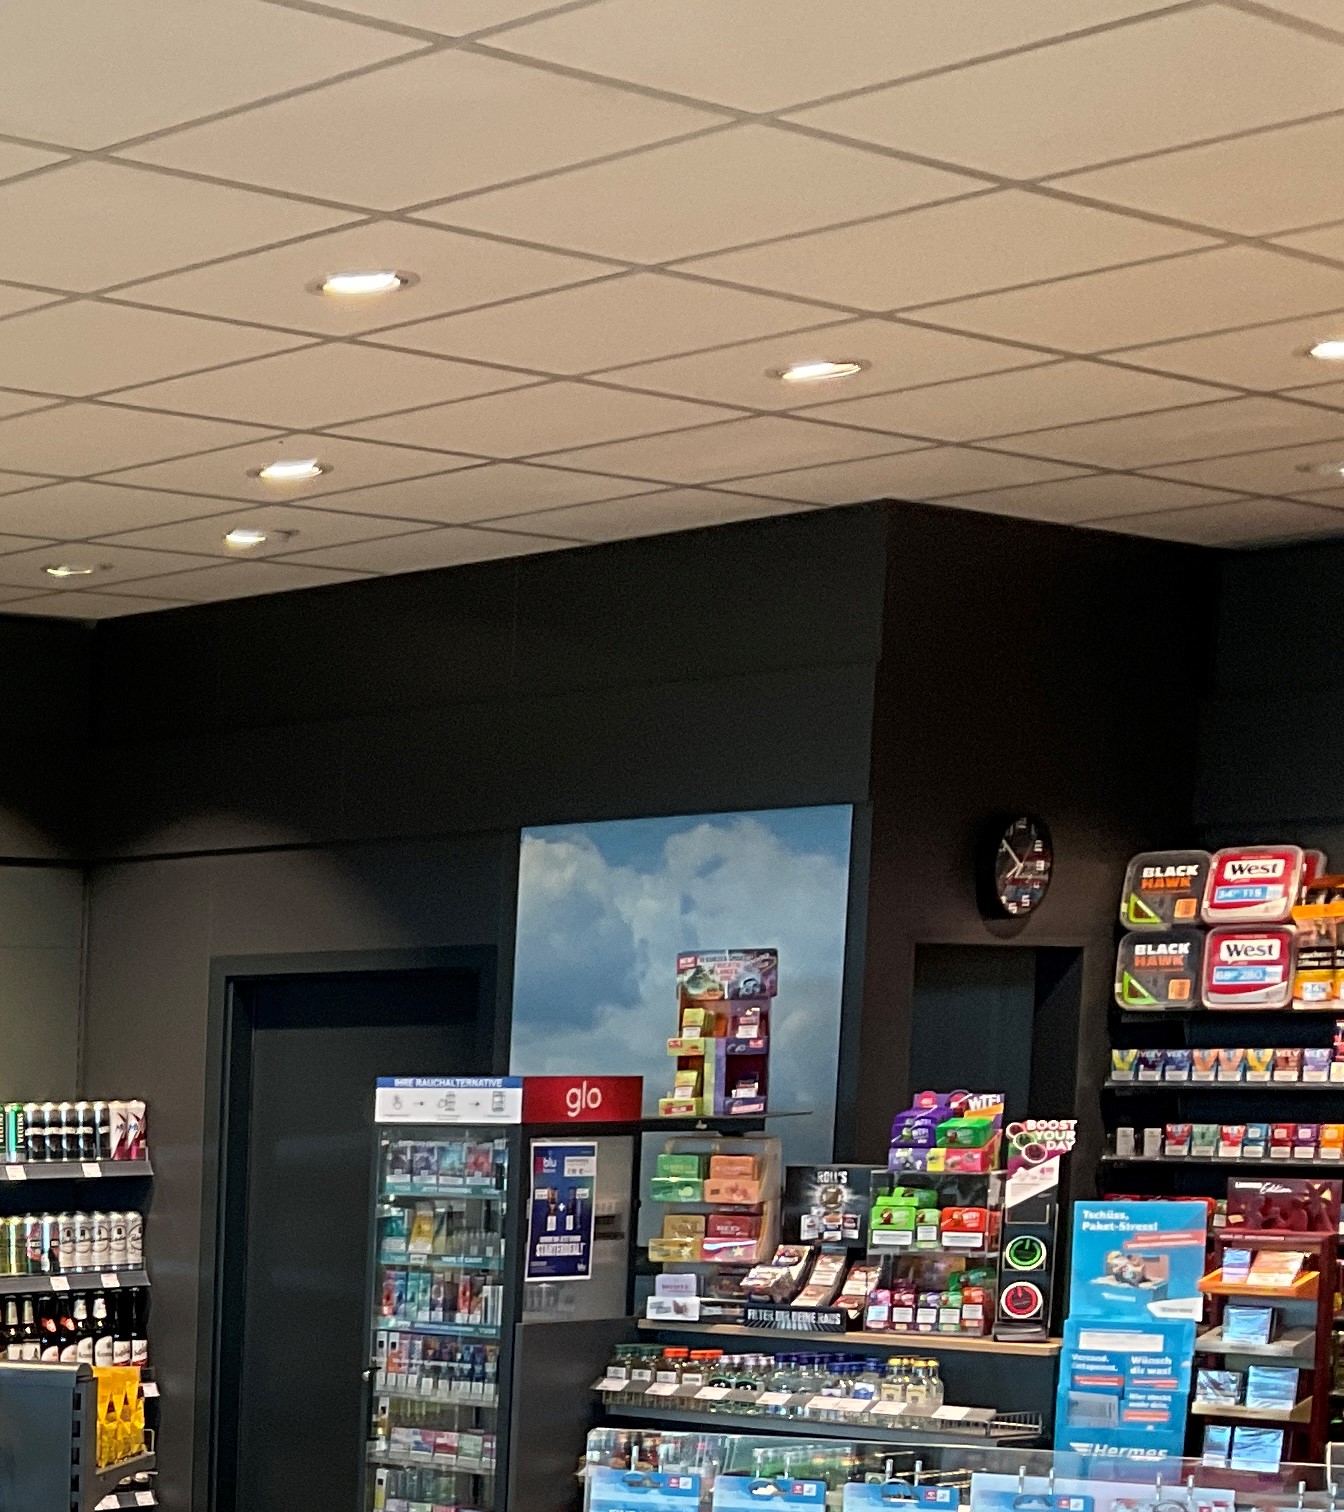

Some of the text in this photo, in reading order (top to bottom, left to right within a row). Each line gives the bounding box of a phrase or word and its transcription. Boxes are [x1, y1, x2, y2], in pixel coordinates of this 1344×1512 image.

[1142, 865, 1199, 877] BLACK
[1231, 863, 1278, 875] West
[1141, 877, 1191, 890] HAWK
[1135, 942, 1190, 955] BLACK
[1226, 943, 1274, 956] West
[1134, 955, 1184, 967] HAWK
[416, 1079, 502, 1088] RAUCHALTERNATIVE
[566, 1081, 602, 1116] glo
[969, 1095, 1001, 1111] WTF!
[1027, 1120, 1077, 1130] BOOST
[1036, 1131, 1076, 1140] YOUR
[1046, 1141, 1074, 1150] DAY
[1131, 1355, 1172, 1366] Wünsch
[1092, 1443, 1168, 1461] Hermes
